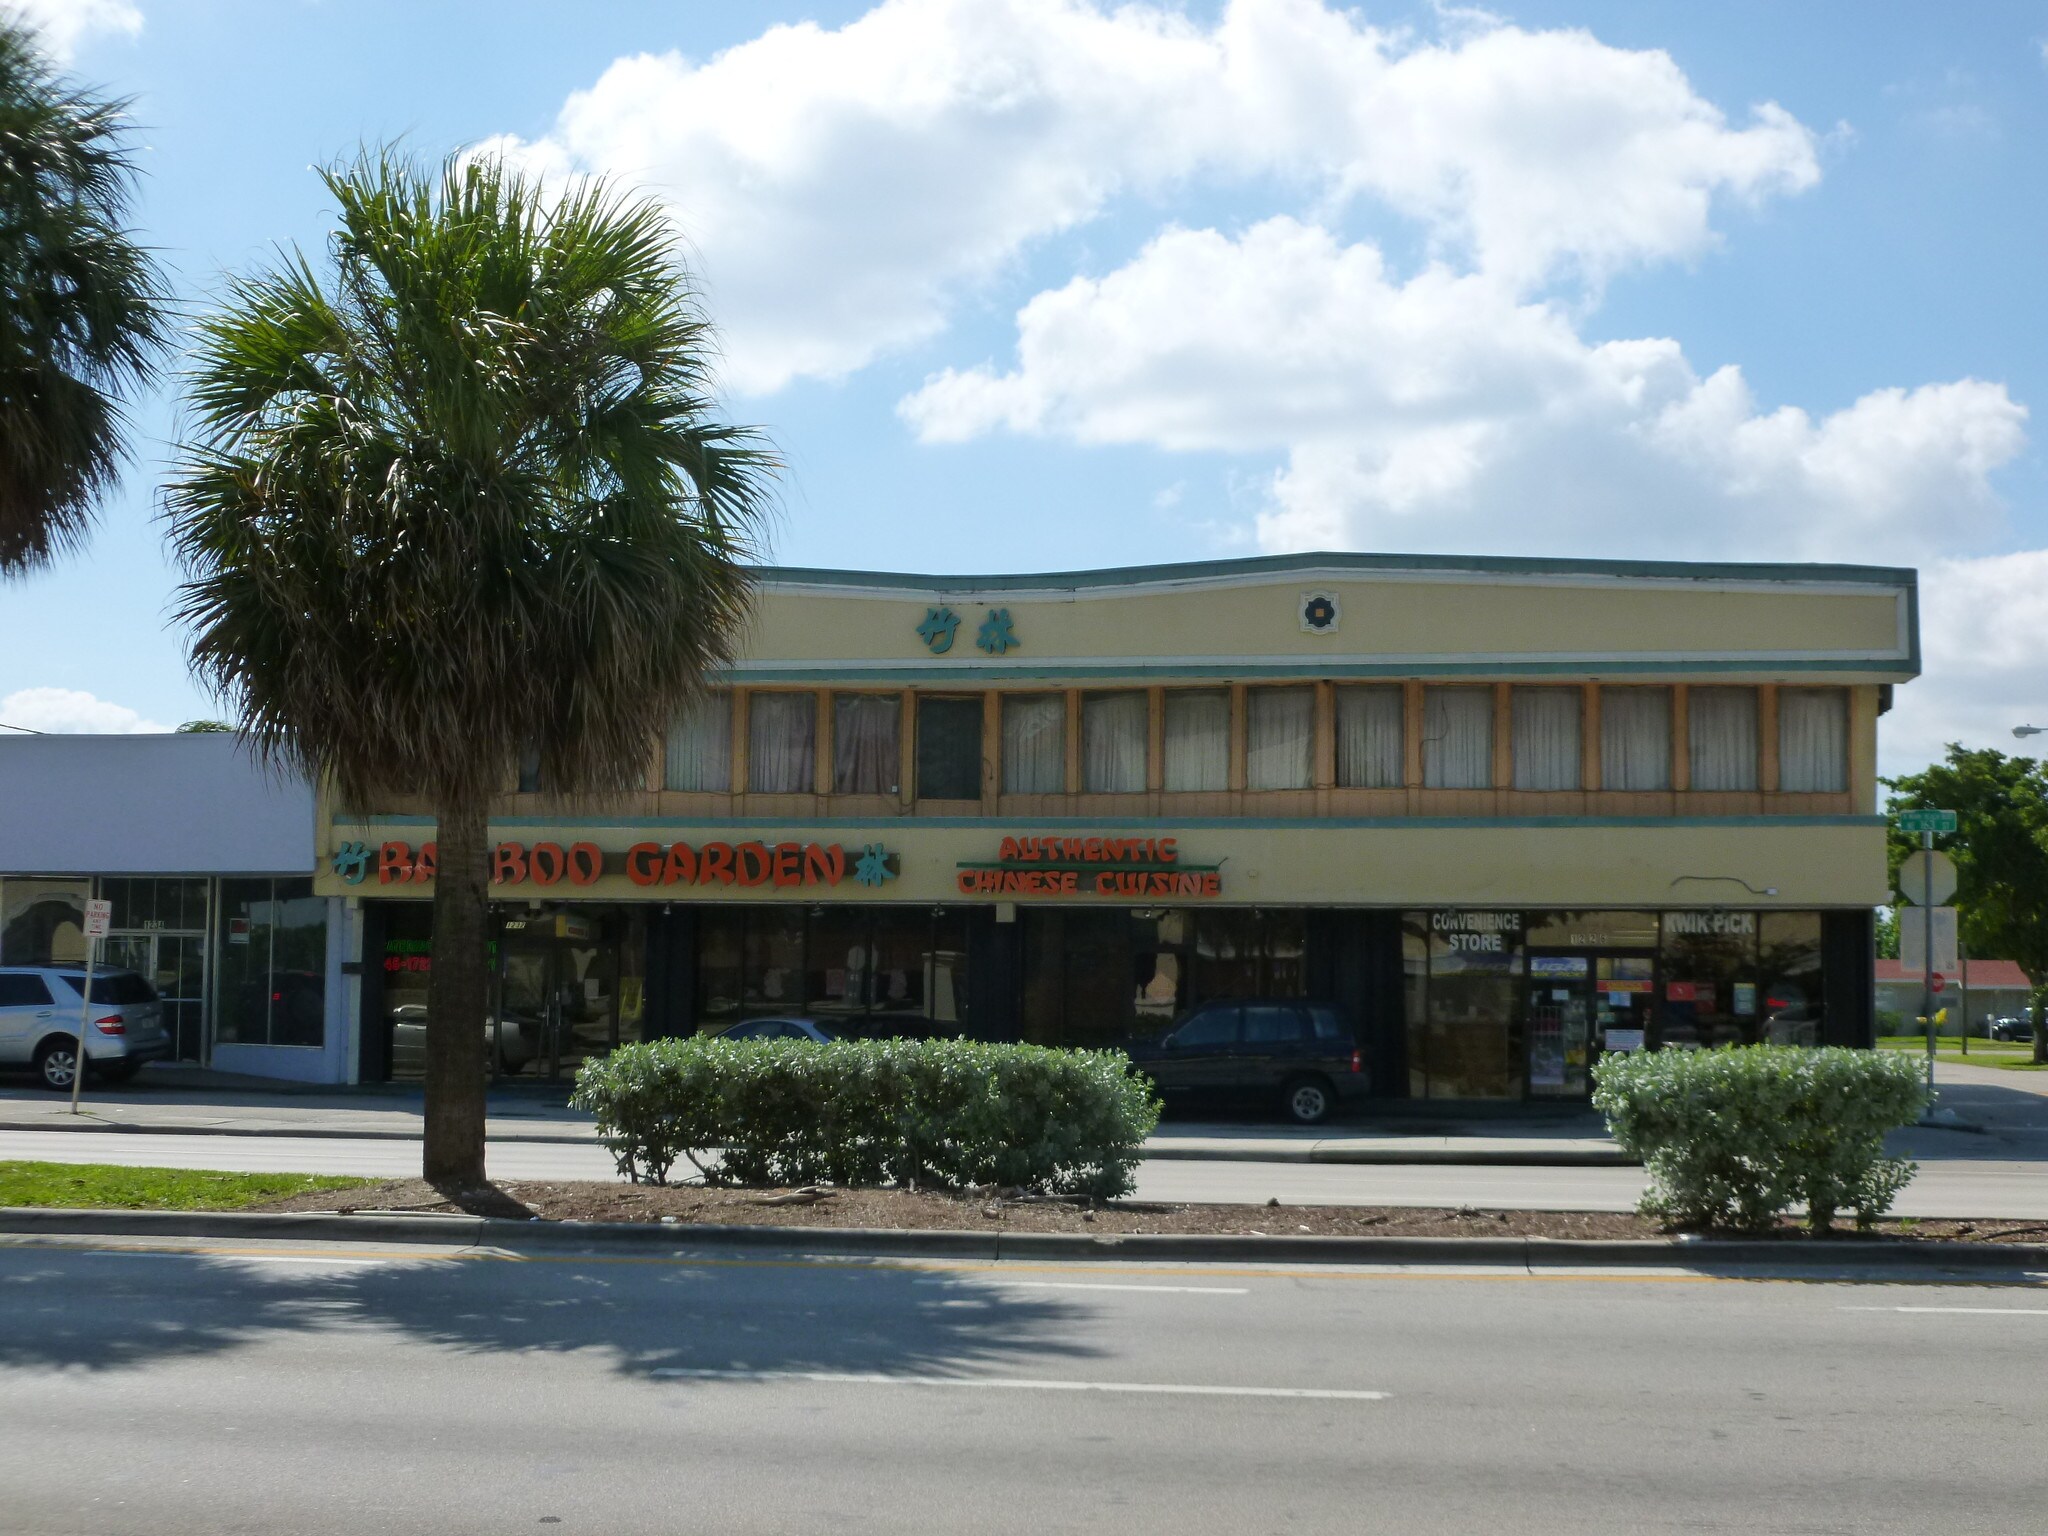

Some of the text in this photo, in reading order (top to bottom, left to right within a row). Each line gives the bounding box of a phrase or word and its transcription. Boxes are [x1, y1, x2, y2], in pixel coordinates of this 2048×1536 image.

[998, 836, 1179, 862] AUTHENTIC
[378, 841, 846, 888] BABOO GARDEN
[956, 869, 1222, 897] CHINESE CUISINE
[85, 911, 110, 919] PARKING
[93, 903, 104, 911] NO
[1432, 913, 1520, 930] CONVENIENCE
[1664, 913, 1755, 934] KWIK PICK
[1449, 934, 1502, 951] STORE
